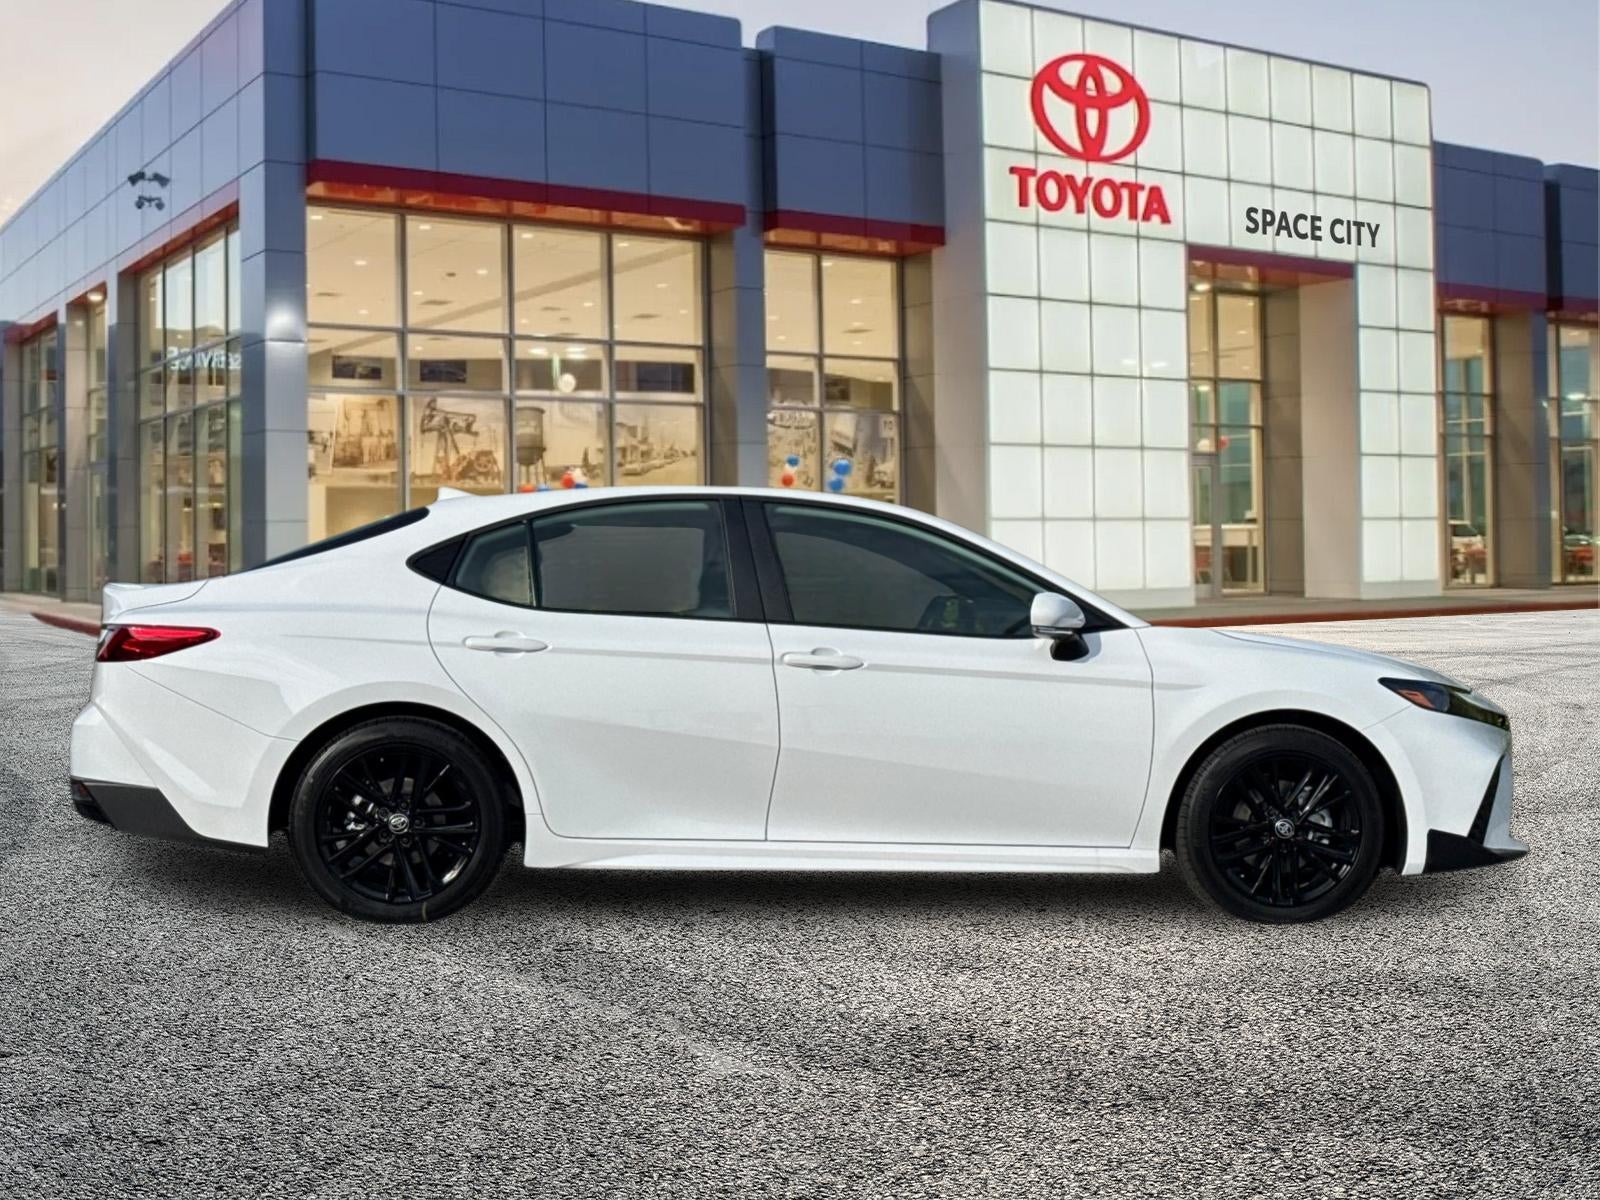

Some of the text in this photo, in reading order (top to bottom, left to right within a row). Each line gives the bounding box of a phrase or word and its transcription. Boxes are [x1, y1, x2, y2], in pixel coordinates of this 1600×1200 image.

[1009, 166, 1171, 225] TOYOTA
[1245, 206, 1380, 248] SPACE CITY
